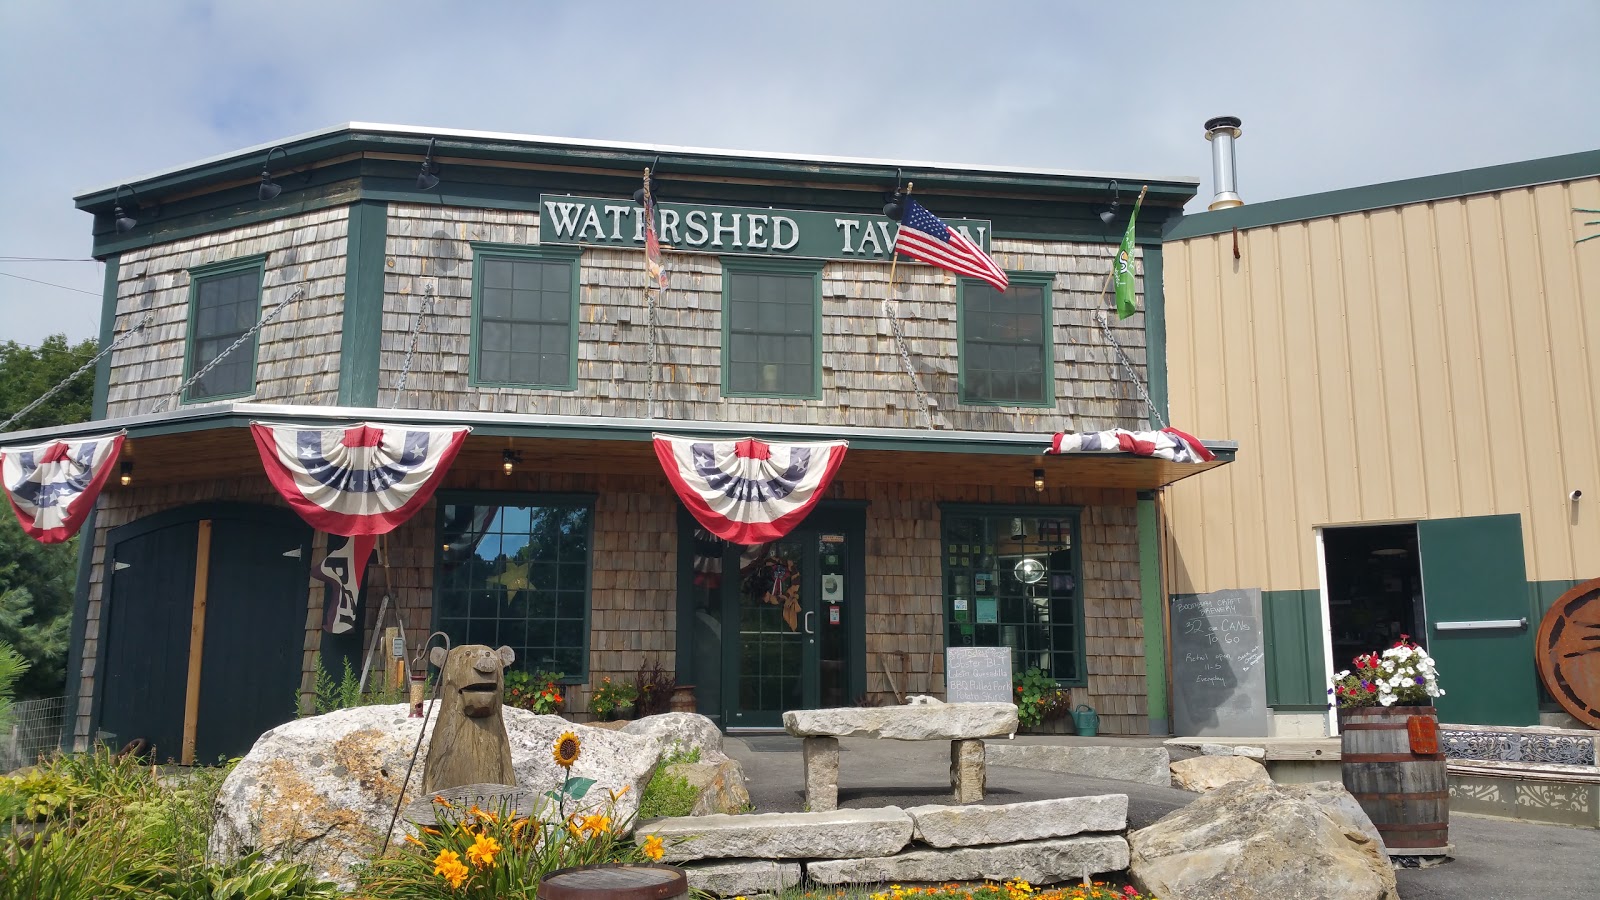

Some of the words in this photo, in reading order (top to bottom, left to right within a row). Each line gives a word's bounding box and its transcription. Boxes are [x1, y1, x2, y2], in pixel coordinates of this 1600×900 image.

[834, 218, 986, 255] TAVN
[1184, 619, 1204, 634] 32
[949, 658, 981, 668] Lobster
[984, 656, 1008, 668] BLT
[950, 680, 969, 691] BBQ
